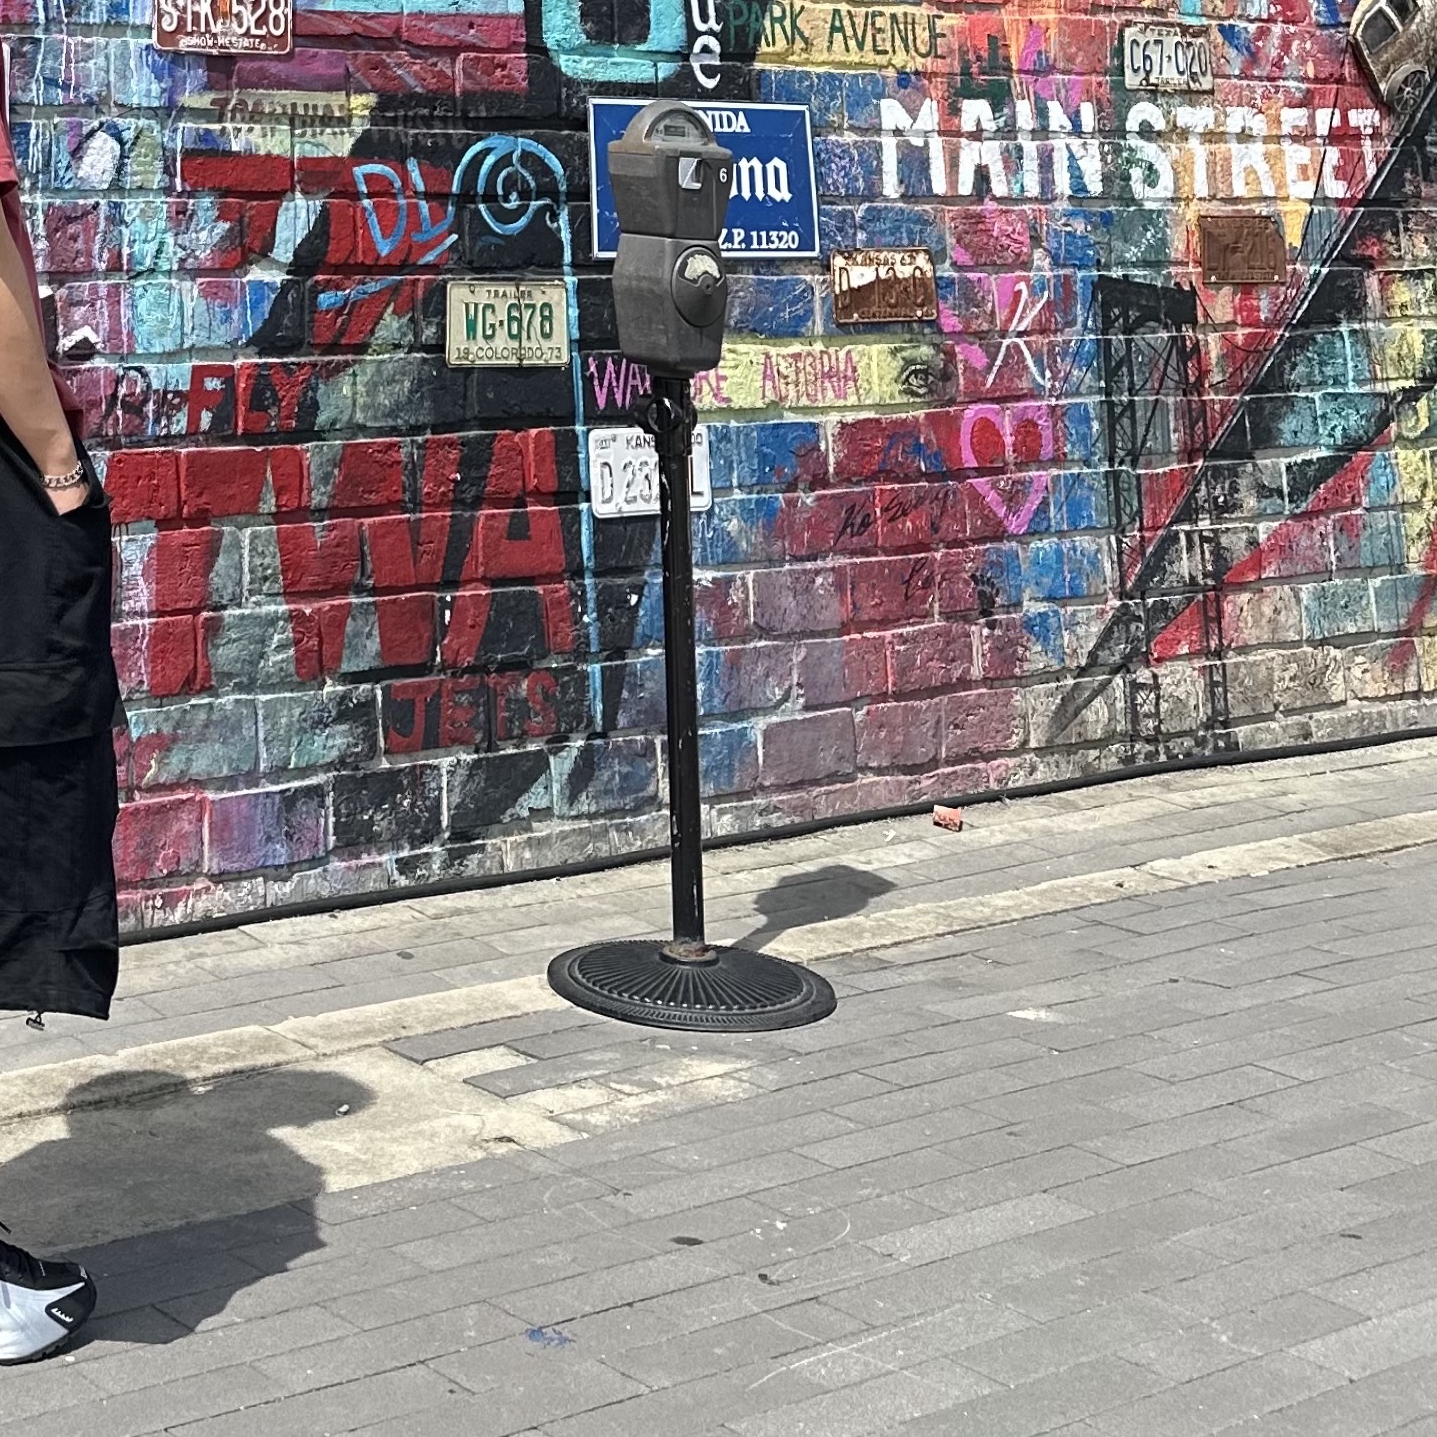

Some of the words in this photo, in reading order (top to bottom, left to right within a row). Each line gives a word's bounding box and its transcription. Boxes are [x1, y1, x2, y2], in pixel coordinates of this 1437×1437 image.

[827, 10, 946, 60] AVENUE
[699, 110, 752, 134] NIDA
[880, 97, 1104, 200] MAIN
[1124, 99, 1382, 201] STREET
[719, 168, 728, 183] 6
[749, 230, 800, 250] 11320
[485, 289, 533, 299] TRAILER
[187, 361, 314, 436] FLY
[103, 427, 574, 698] TWA
[383, 669, 560, 754] JETS
